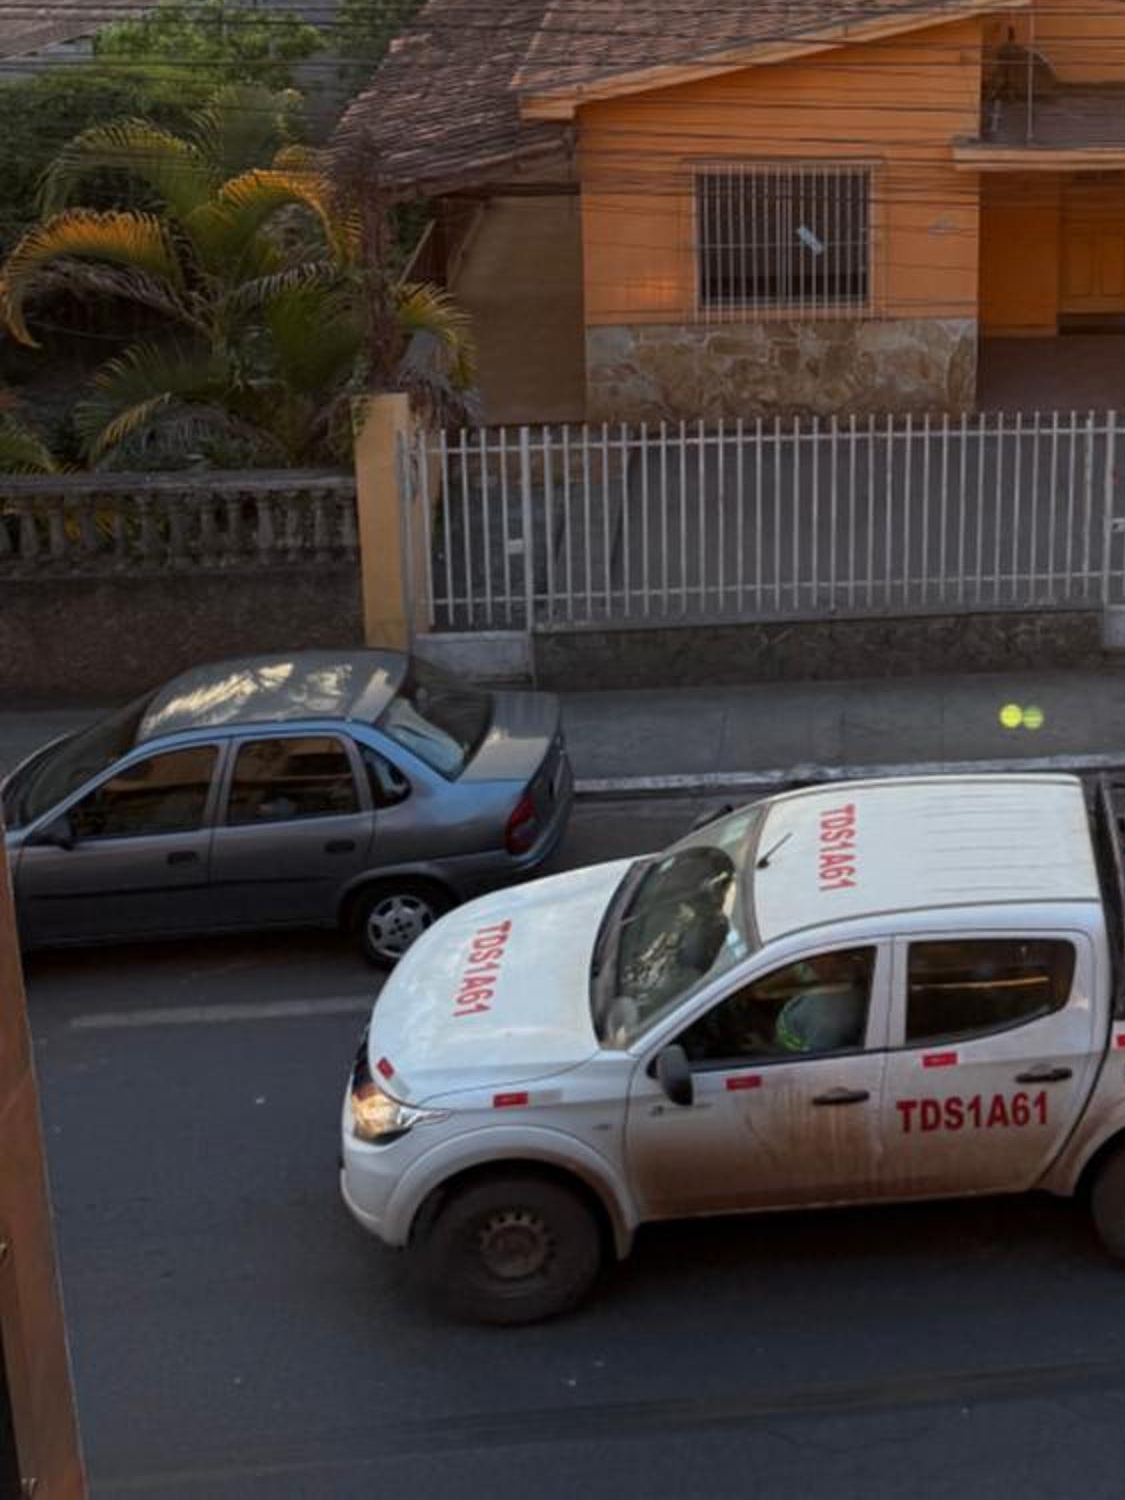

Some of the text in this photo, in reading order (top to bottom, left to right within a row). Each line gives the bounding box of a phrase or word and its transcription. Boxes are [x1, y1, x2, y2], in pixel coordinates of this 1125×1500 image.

[819, 804, 857, 892] TDS1A61
[453, 920, 513, 1017] TDS1A61
[896, 1091, 1048, 1133] TDS1A61
